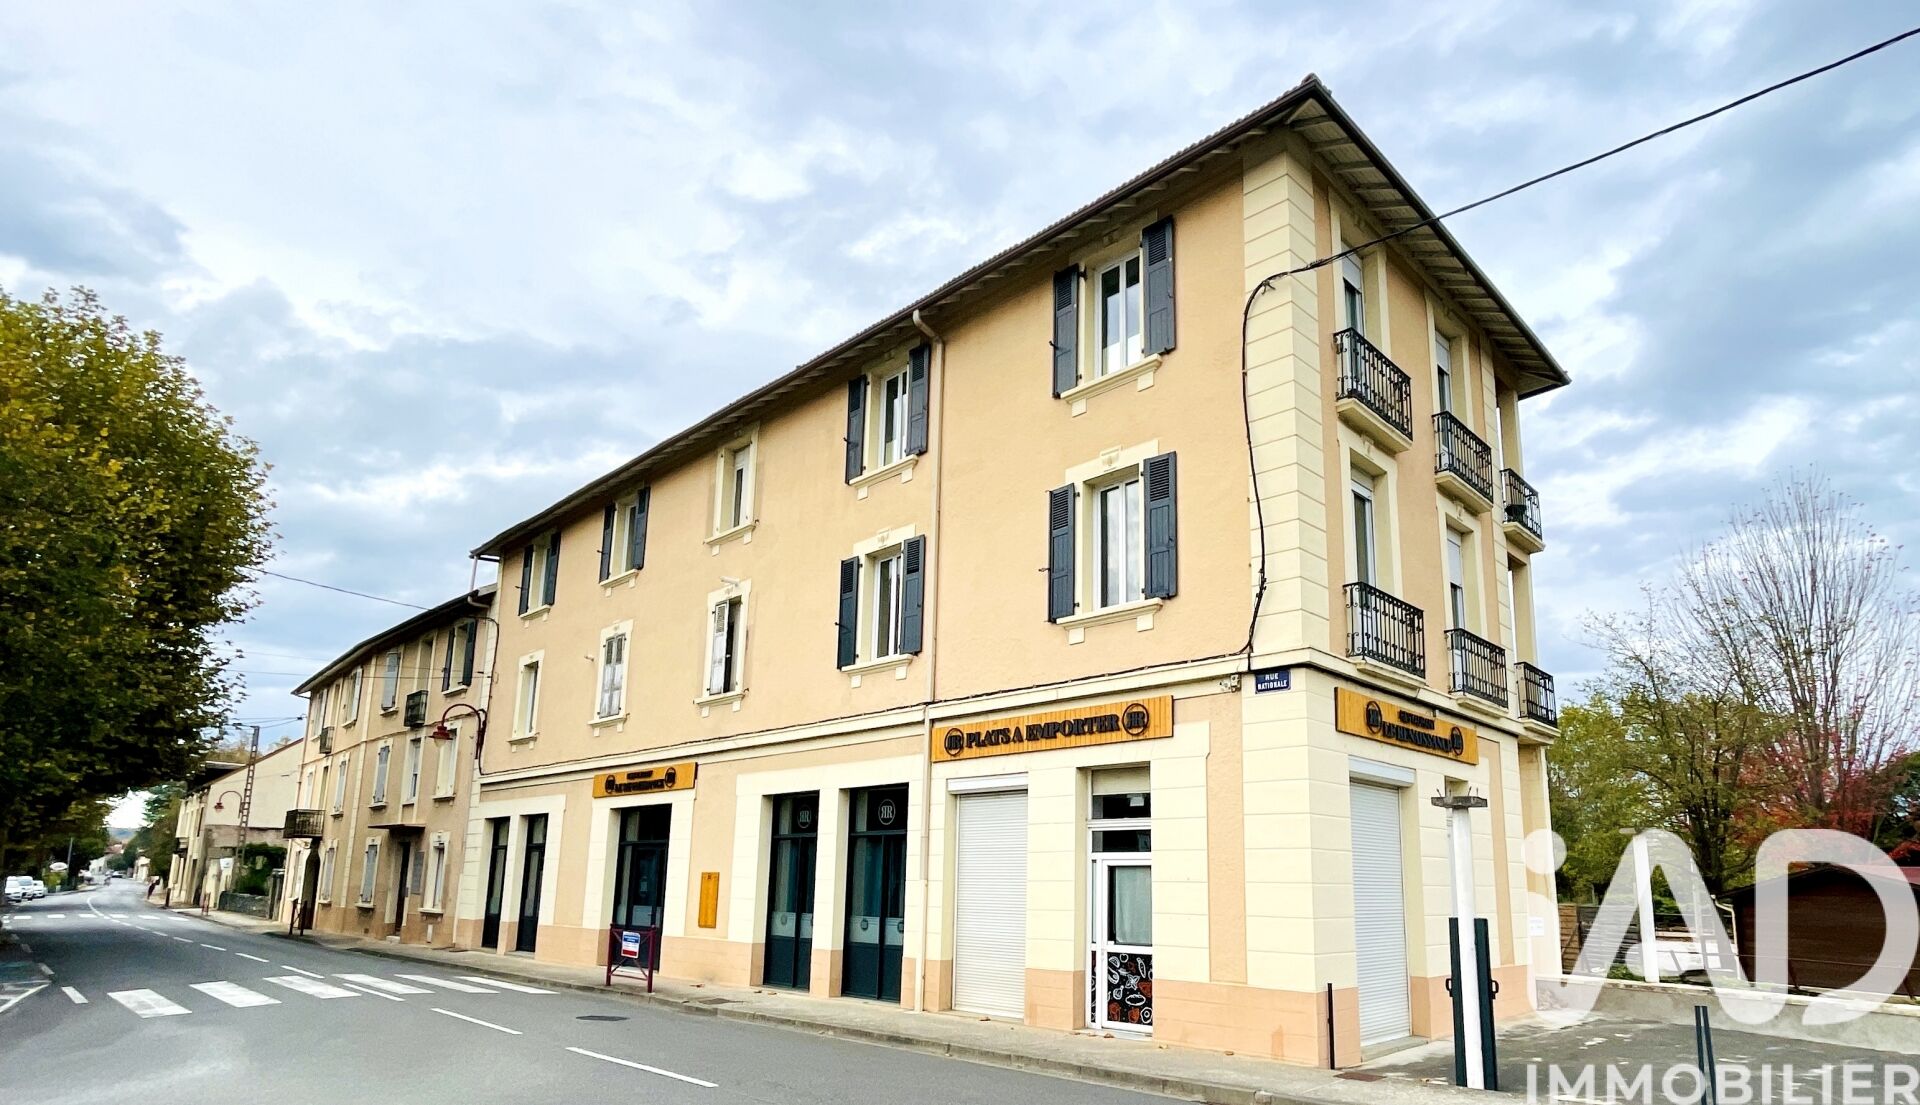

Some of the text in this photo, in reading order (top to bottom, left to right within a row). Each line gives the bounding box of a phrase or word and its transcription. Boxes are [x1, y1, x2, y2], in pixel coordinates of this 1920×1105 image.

[1265, 673, 1279, 681] RUE
[1257, 680, 1288, 690] NATIONALE
[966, 727, 1011, 748] PLATS
[1012, 726, 1023, 743] A
[1025, 714, 1120, 741] EMPORTER
